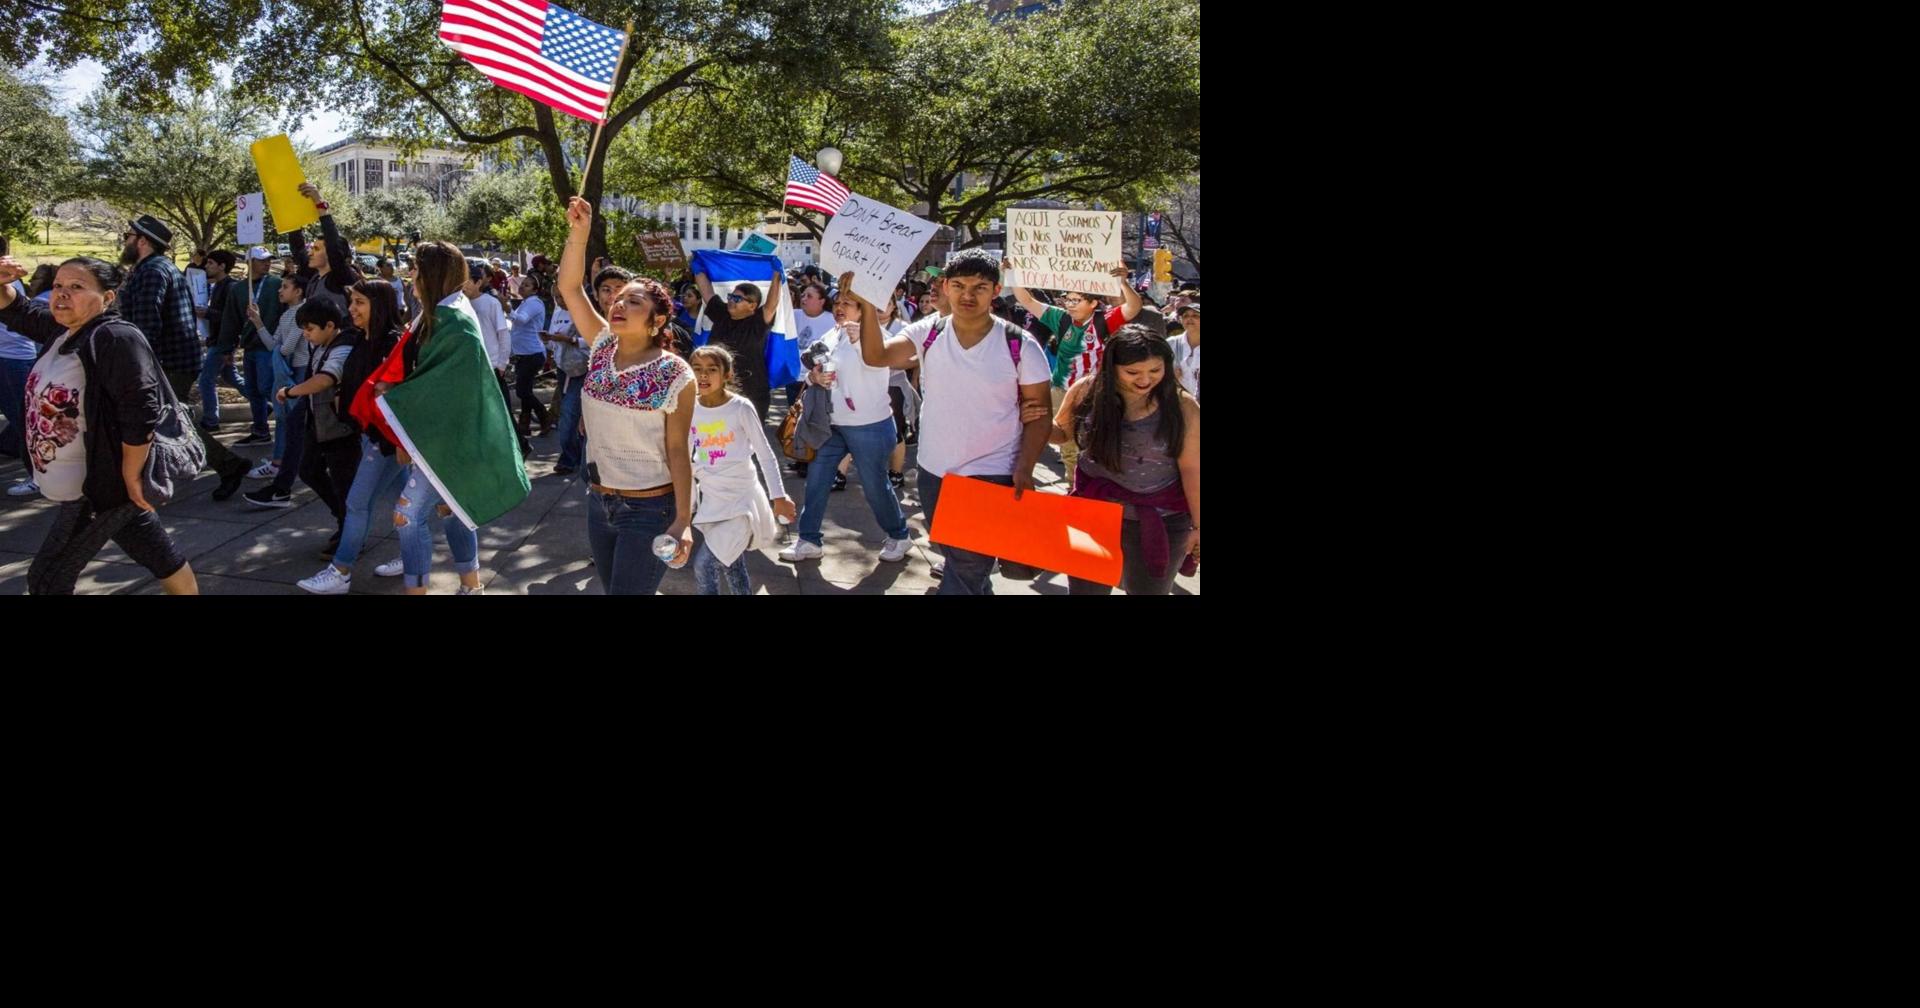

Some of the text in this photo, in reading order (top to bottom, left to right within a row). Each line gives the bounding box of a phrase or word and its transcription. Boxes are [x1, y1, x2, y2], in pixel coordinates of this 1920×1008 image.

[879, 212, 922, 240] Break
[1014, 211, 1050, 227] AQUI
[1106, 214, 1117, 230] Y
[1014, 228, 1112, 246] NO NOS VAMOS Y
[1012, 242, 1093, 259] SI NOS HECHAN
[1013, 257, 1041, 271] NOS
[708, 450, 727, 465] you
